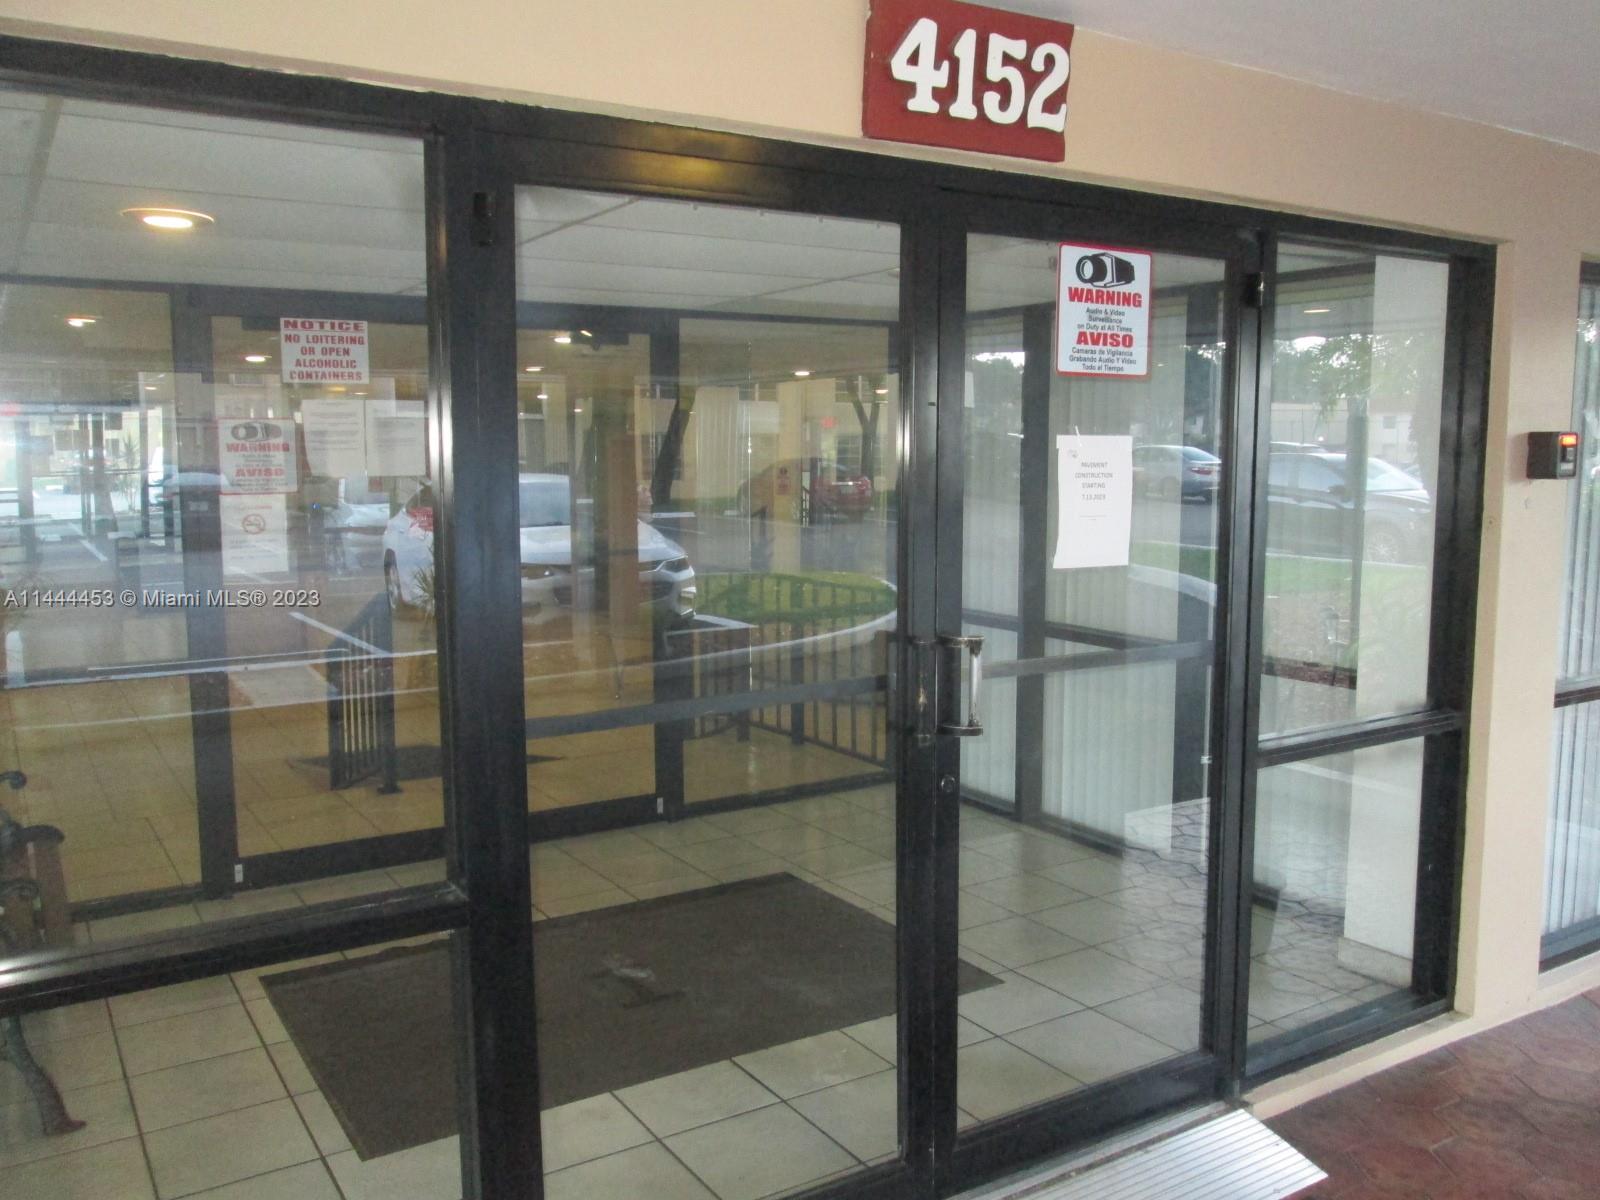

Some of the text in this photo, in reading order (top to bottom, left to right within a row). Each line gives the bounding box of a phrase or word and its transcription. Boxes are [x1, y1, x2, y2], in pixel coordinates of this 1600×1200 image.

[890, 17, 1070, 133] 4152
[1067, 286, 1142, 308] WARNING
[1086, 306, 1103, 315] Audio
[1110, 309, 1126, 317] Video
[1088, 315, 1123, 324] Surveillance
[283, 319, 365, 331] NOTICE
[1086, 323, 1099, 332] Duty
[284, 333, 365, 345] NO LOITERING
[1076, 331, 1134, 348] AVISO
[300, 346, 350, 356] OR OPEN
[1106, 349, 1133, 357] Vigilancia
[295, 358, 357, 369] ALCOHOLIC
[1069, 354, 1097, 362] Grabando
[1098, 356, 1115, 364] Audio
[1104, 364, 1124, 373] Tiempo
[289, 370, 362, 380] CONTAINERS
[235, 467, 285, 477] AVISO
